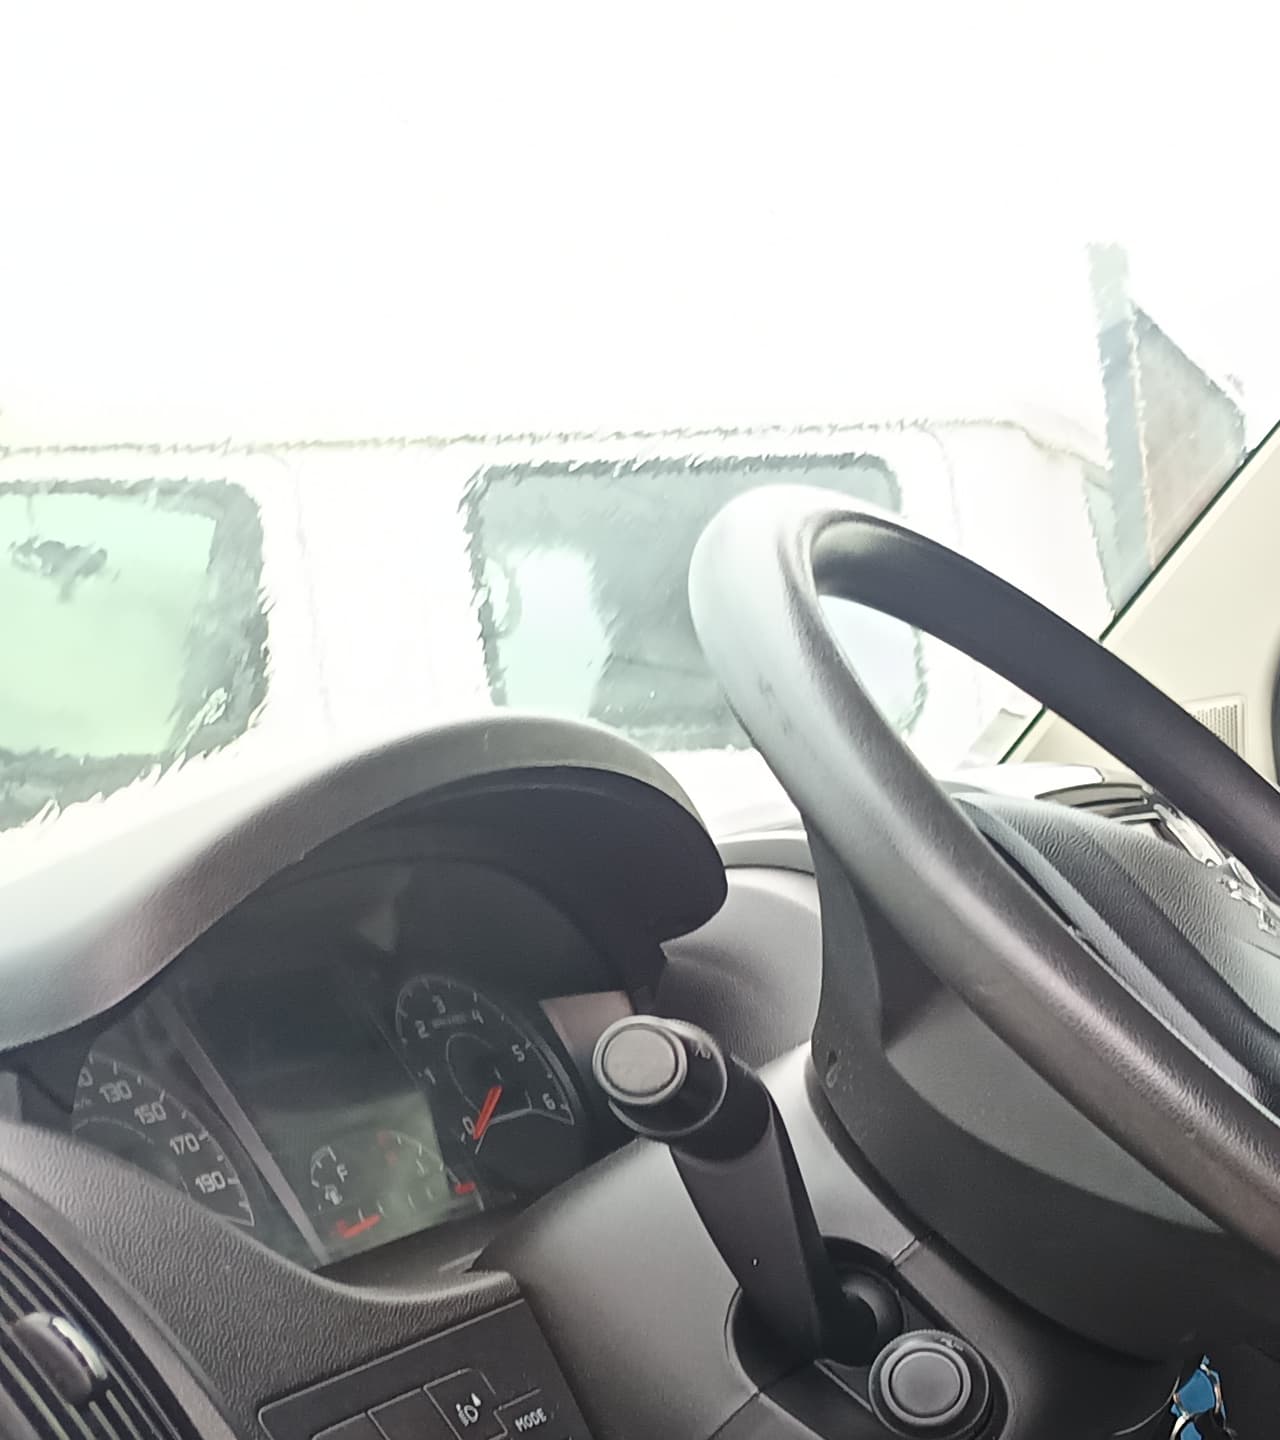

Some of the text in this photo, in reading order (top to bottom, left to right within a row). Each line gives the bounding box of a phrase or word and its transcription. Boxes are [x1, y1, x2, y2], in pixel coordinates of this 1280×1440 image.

[432, 995, 446, 1014] 3
[472, 1008, 484, 1024] 4
[415, 1020, 430, 1038] 2
[512, 1044, 525, 1062] 5
[99, 1080, 132, 1103] 130
[542, 1093, 556, 1110] 6
[134, 1101, 166, 1125] 150
[462, 1116, 475, 1135] 0
[169, 1132, 200, 1155] 170
[195, 1171, 226, 1194] 190
[515, 1407, 547, 1432] MODE
